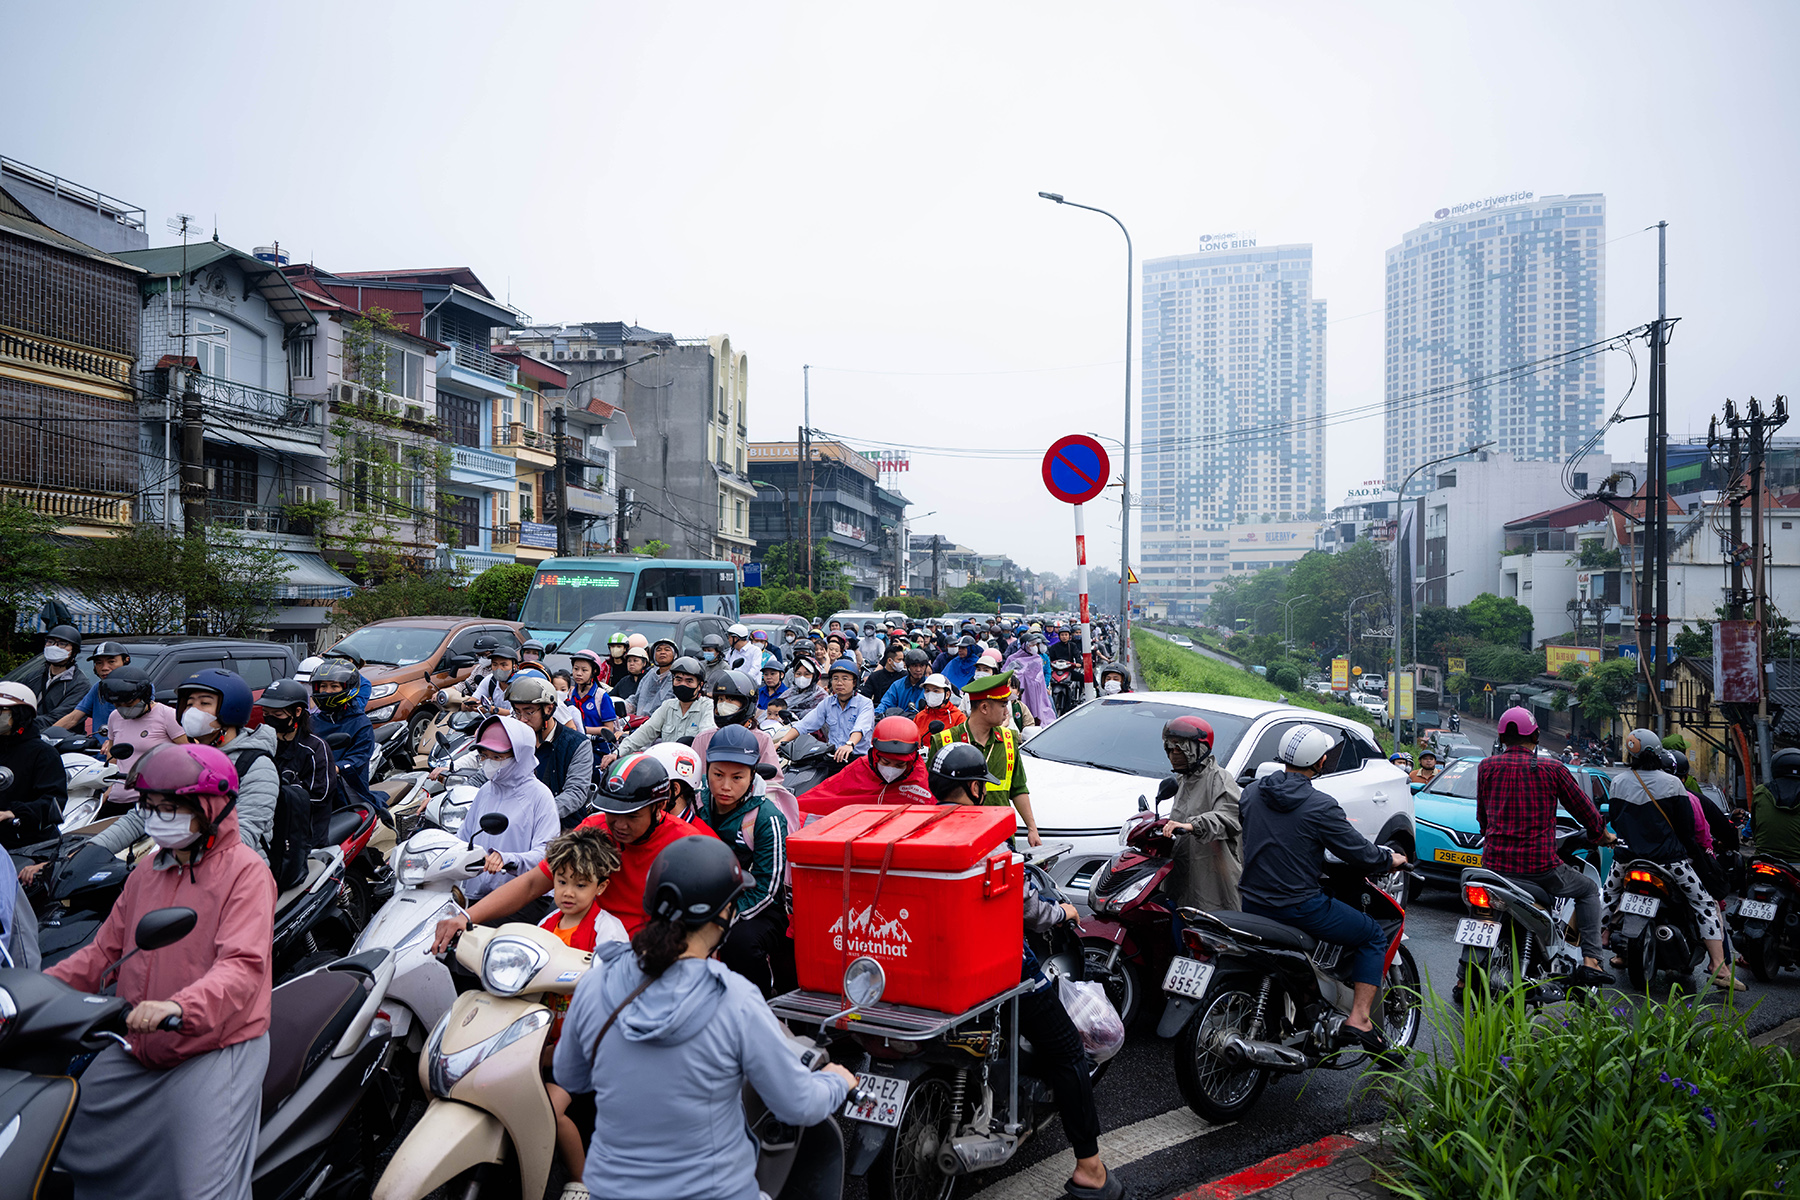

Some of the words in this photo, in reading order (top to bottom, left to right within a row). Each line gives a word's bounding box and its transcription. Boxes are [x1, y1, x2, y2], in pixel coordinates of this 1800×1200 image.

[1451, 202, 1482, 214] mipec
[1485, 190, 1533, 207] riverside
[1199, 241, 1229, 252] LONG
[749, 448, 820, 457] BILLIARS
[1347, 488, 1369, 497] SAO
[1004, 731, 1014, 772] CAHN
[1439, 851, 1483, 866] 29E-489.
[1627, 894, 1653, 906] 30-K5
[1624, 902, 1651, 915] 8466
[1463, 920, 1495, 935] 30-P6
[847, 936, 908, 957] vietnhat
[1460, 932, 1491, 946] 2491
[1174, 960, 1208, 980] 30-Y2
[1168, 974, 1201, 996] 9552
[859, 1075, 899, 1101] 29-E2
